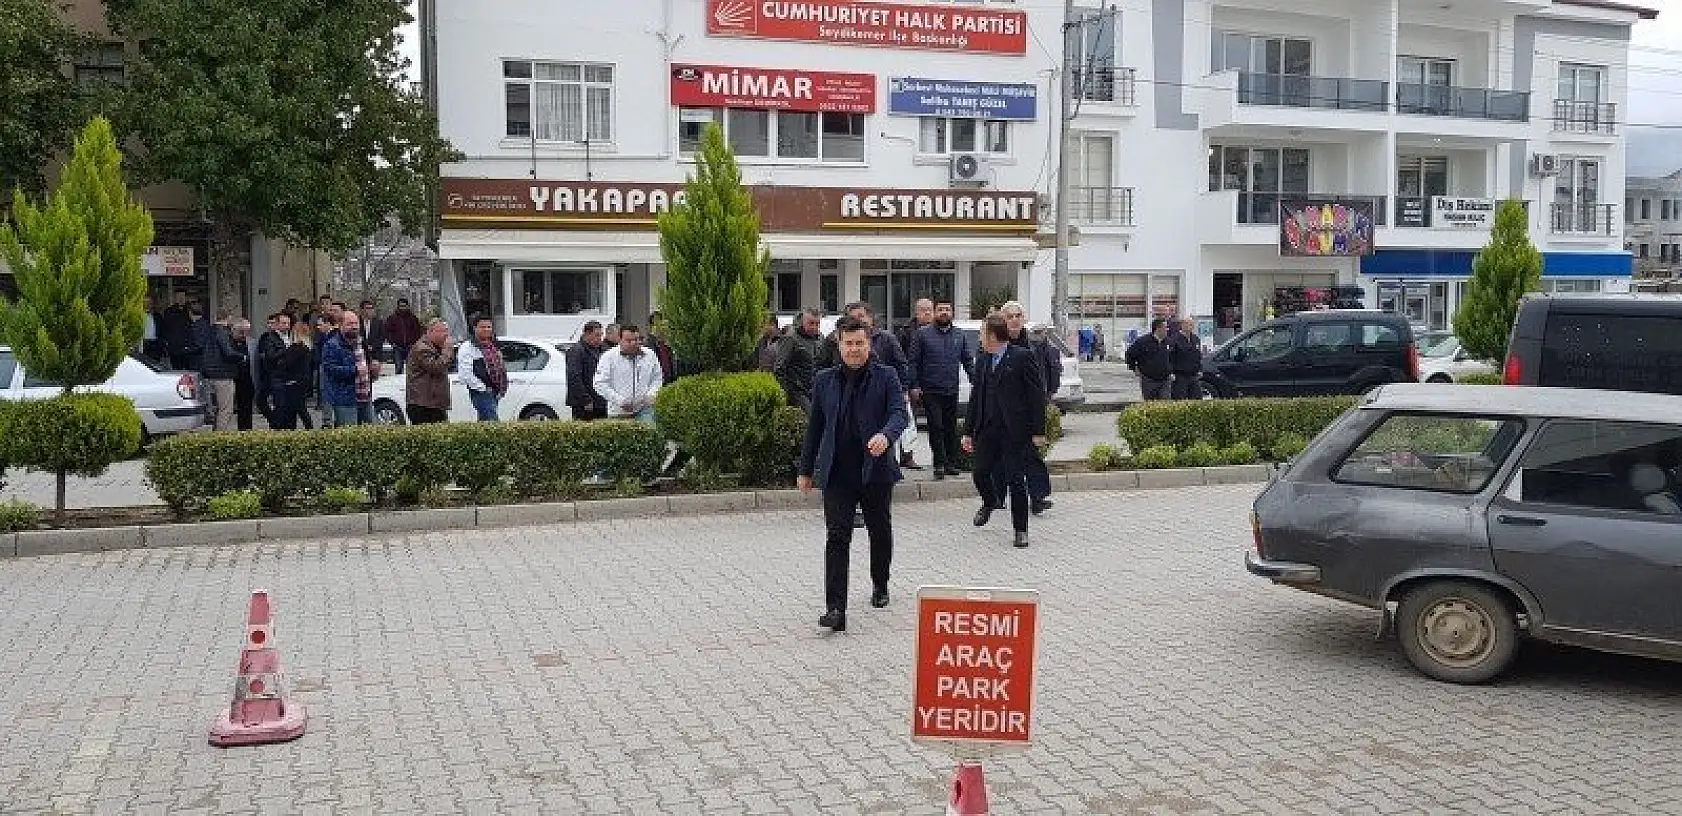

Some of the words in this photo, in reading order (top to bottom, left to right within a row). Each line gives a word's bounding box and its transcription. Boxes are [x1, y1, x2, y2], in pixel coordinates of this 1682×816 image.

[762, 1, 889, 26] CUMHURİYET
[895, 11, 945, 30] HALK
[951, 13, 1021, 35] PARTİSİ
[701, 69, 812, 99] MİMAR
[841, 192, 1034, 220] RESTAURANT
[934, 610, 1020, 638] RESMİ
[935, 642, 1013, 674] ARAÇ
[937, 676, 1010, 701] PARK
[918, 703, 1027, 735] YERİDİR
